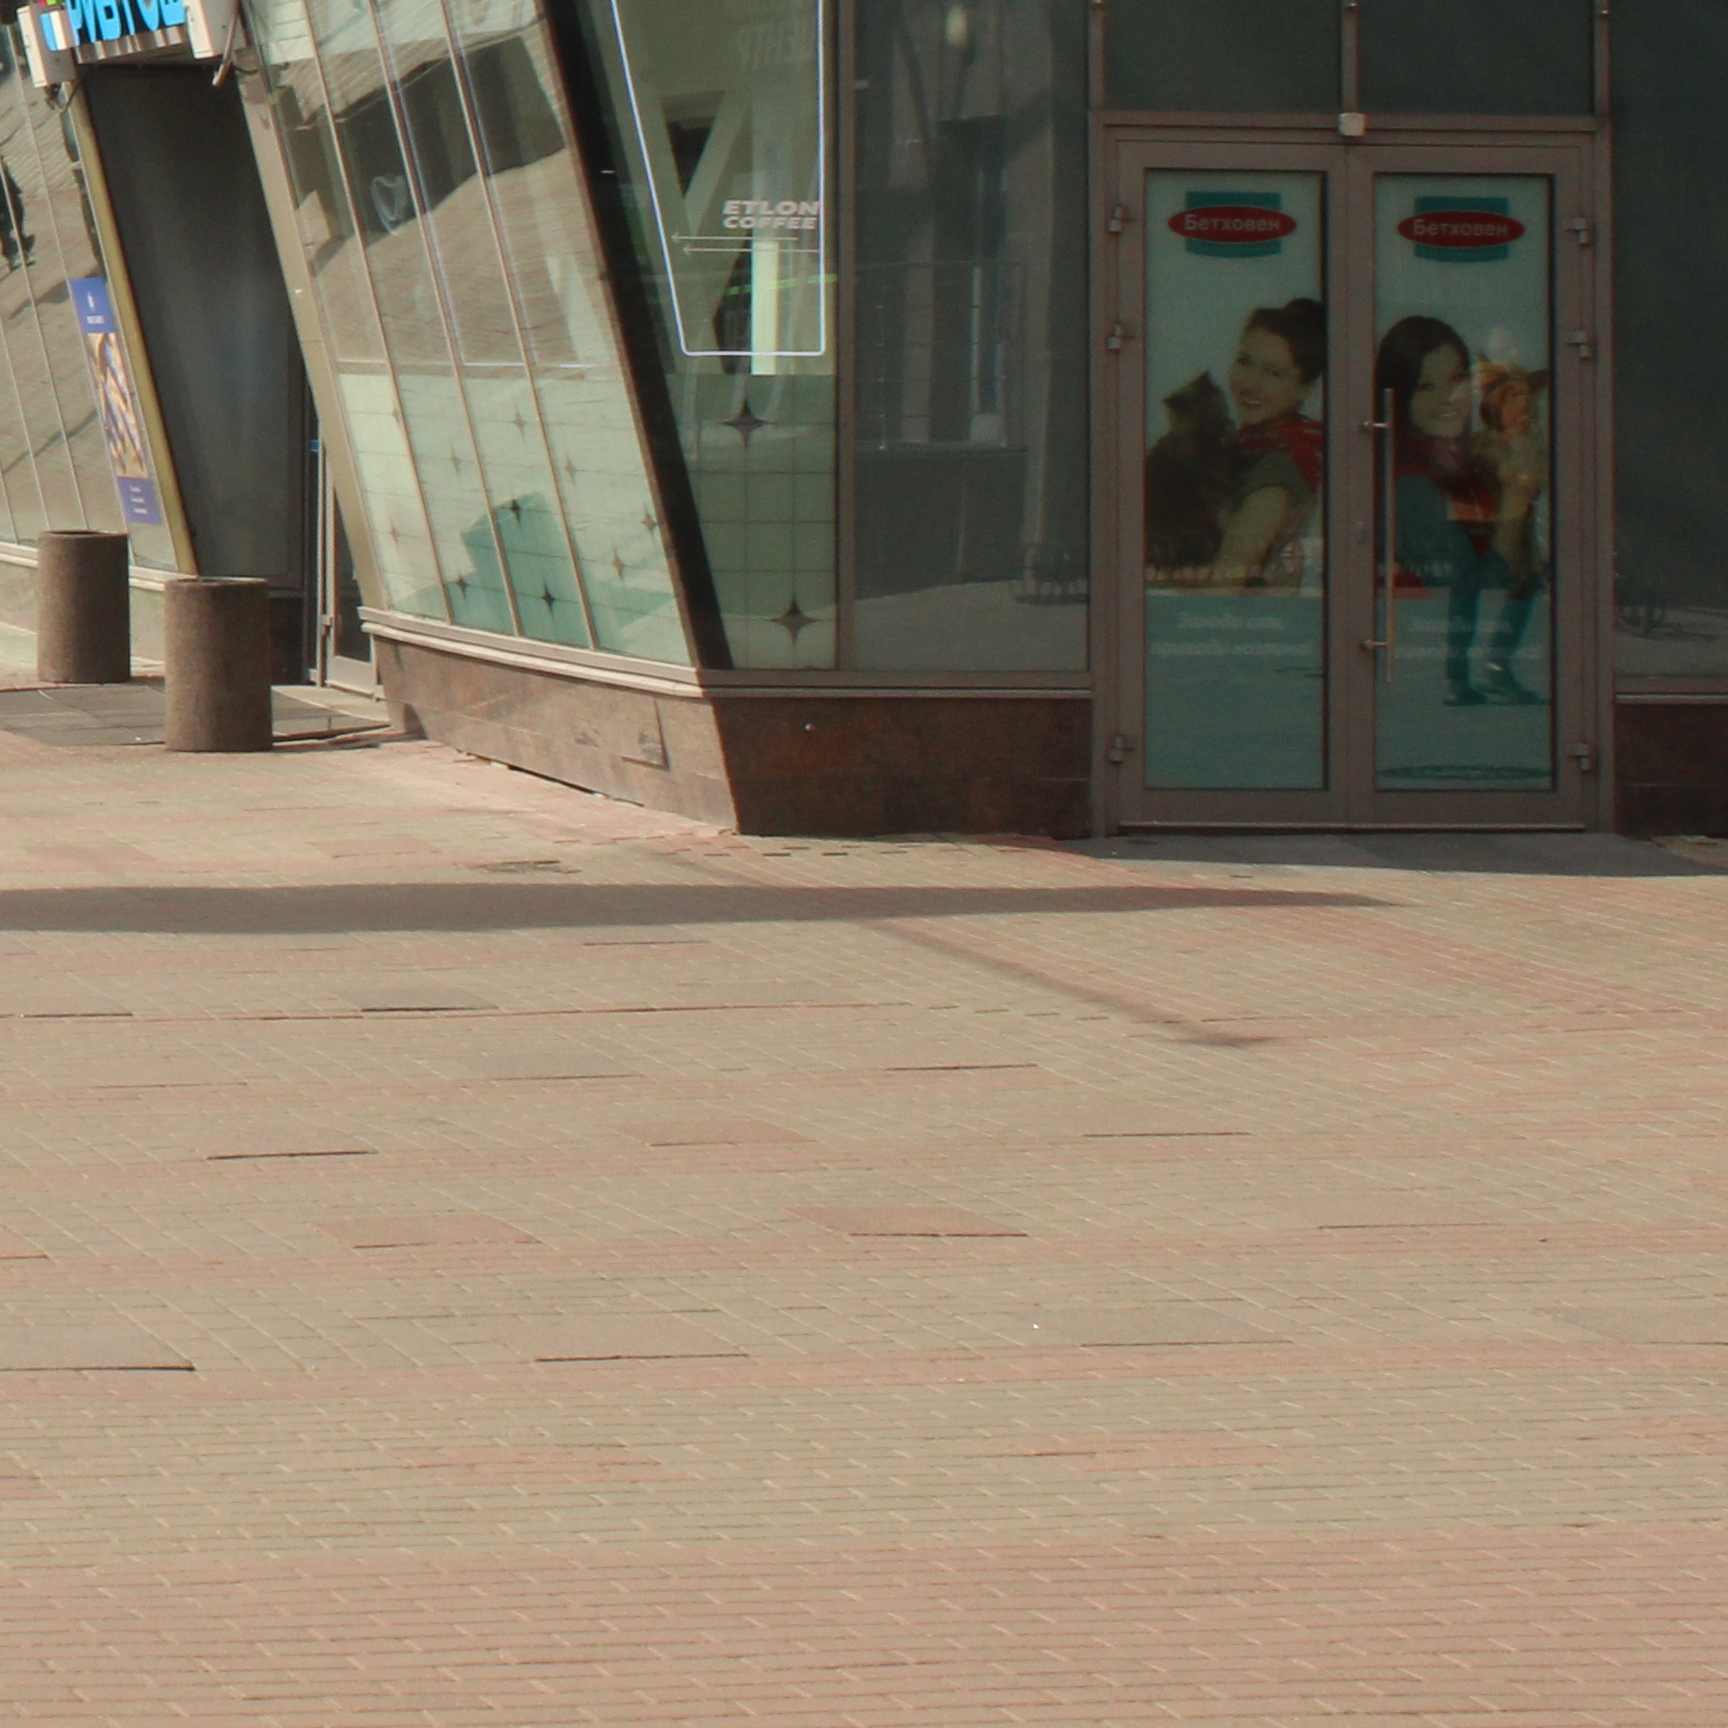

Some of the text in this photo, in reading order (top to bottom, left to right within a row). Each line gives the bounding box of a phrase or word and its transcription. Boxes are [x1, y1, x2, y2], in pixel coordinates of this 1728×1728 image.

[722, 200, 819, 215] ETLON
[724, 216, 817, 229] COFFEE
[1184, 214, 1280, 232] Бетховен
[1413, 219, 1509, 236] Бетховен
